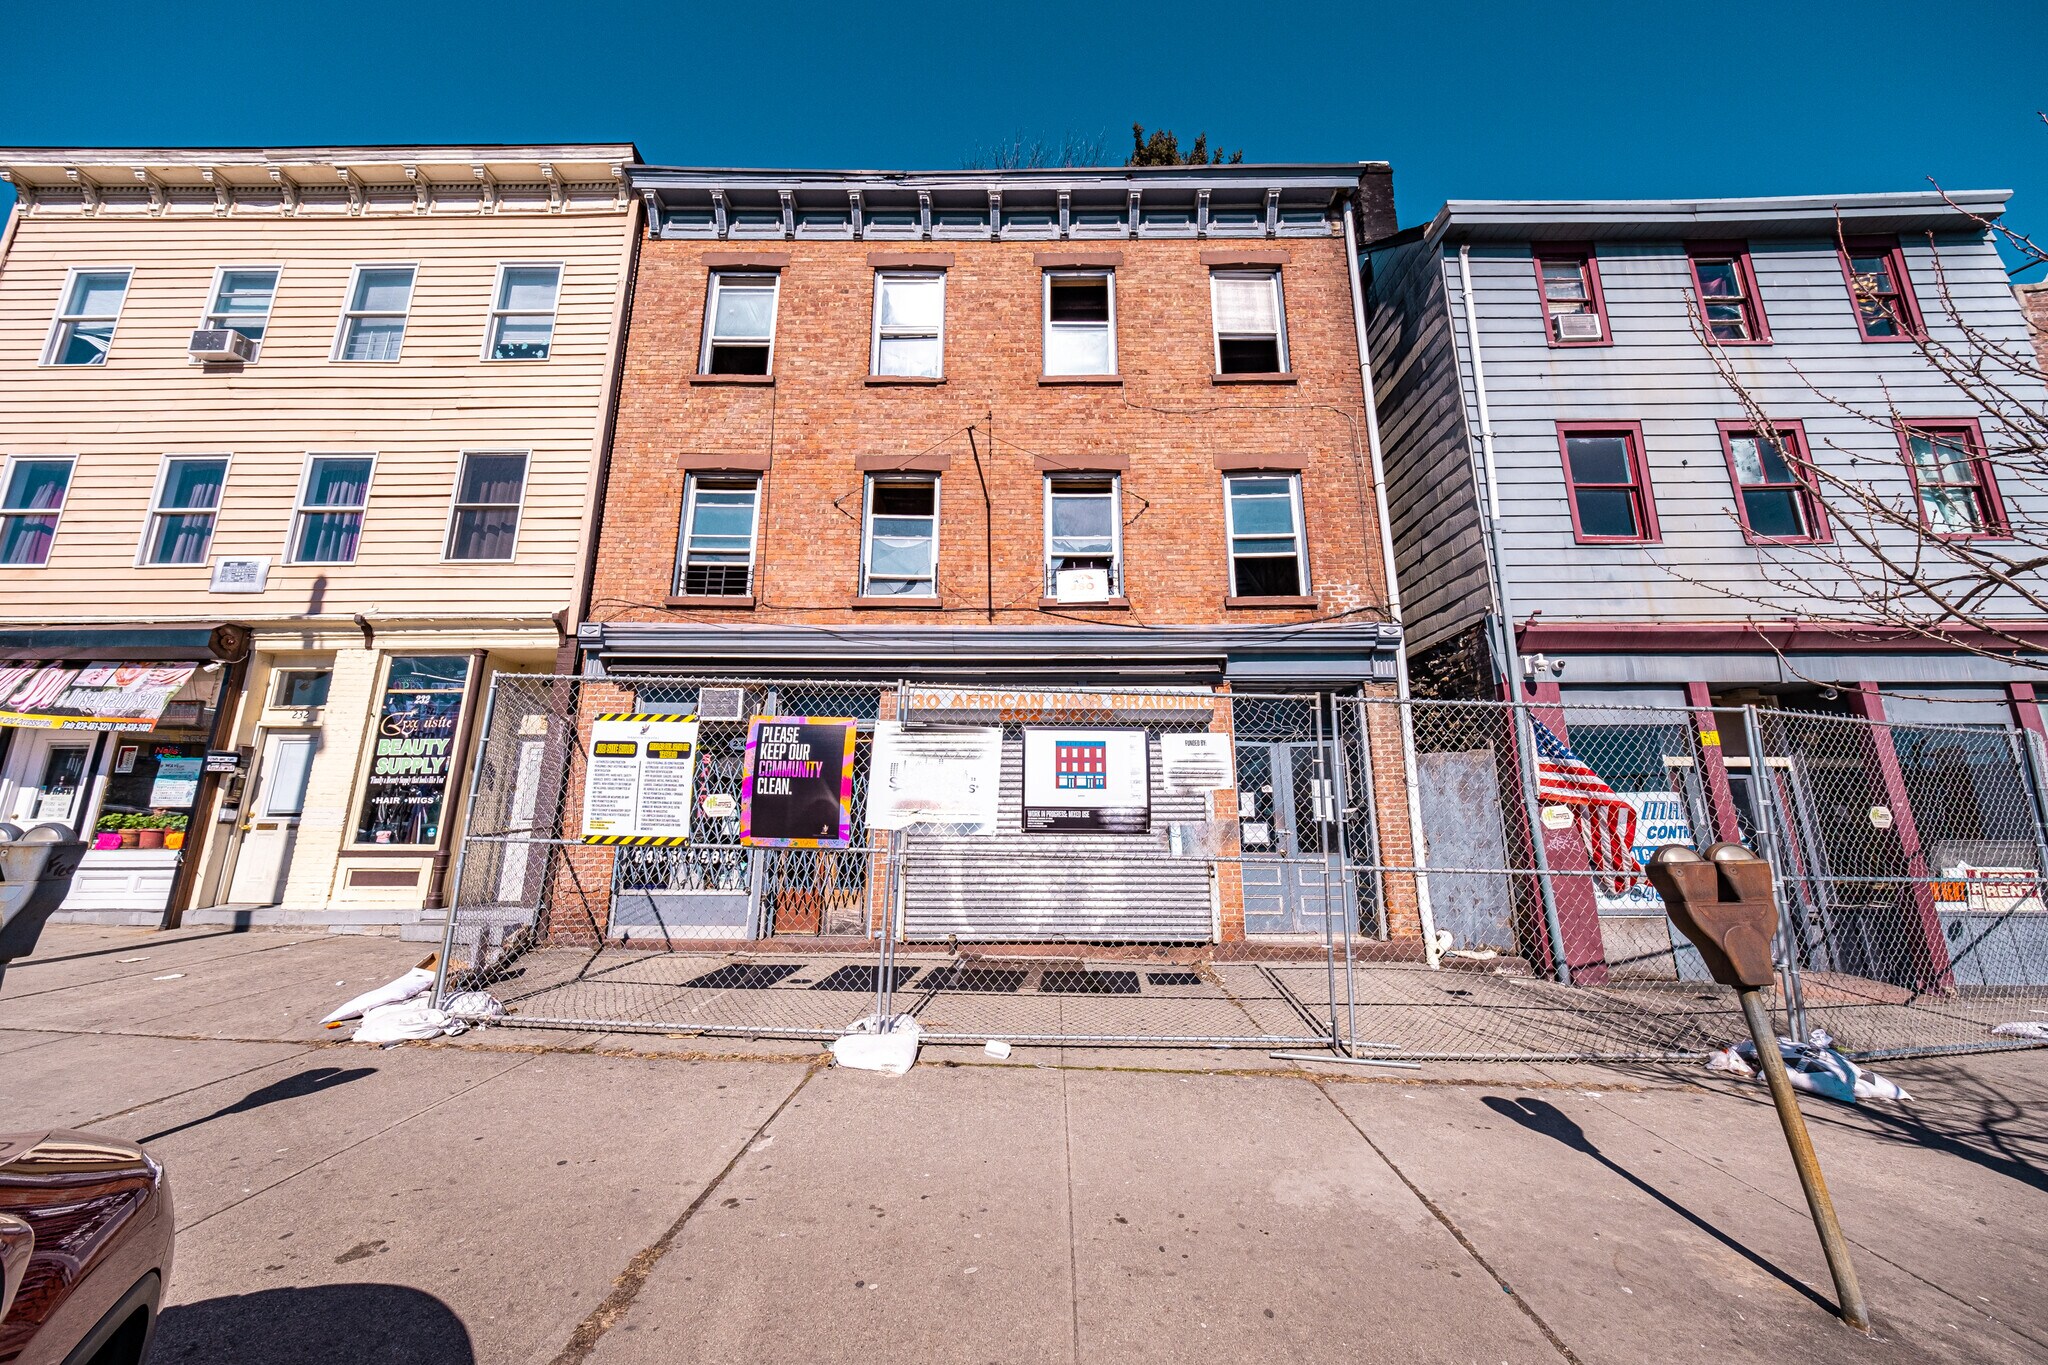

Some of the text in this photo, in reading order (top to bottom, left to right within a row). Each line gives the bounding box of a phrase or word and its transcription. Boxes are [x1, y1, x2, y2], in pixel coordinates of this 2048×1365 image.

[414, 694, 431, 704] 232
[951, 693, 1044, 709] AFRICAN
[1053, 693, 1102, 709] HAIR
[1110, 693, 1215, 709] BRAIDING
[291, 710, 310, 719] 232
[762, 726, 800, 743] PLEASE
[377, 738, 450, 756] BEAUTY
[760, 743, 811, 760] KEEP OUR
[375, 755, 447, 775] SUPPLY
[758, 760, 823, 778] COMMUNITY
[757, 778, 793, 795] CLEAN.
[1985, 885, 2034, 897] RENT
